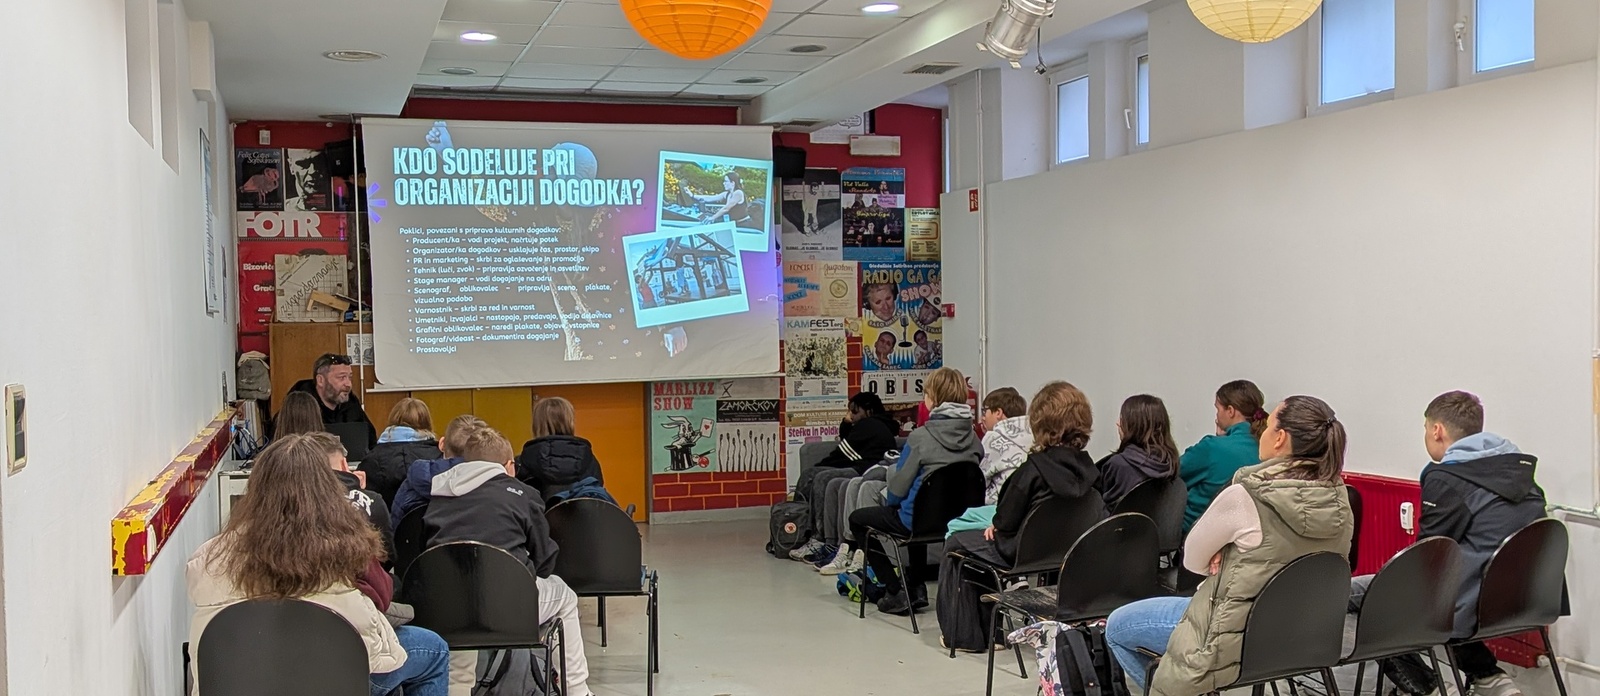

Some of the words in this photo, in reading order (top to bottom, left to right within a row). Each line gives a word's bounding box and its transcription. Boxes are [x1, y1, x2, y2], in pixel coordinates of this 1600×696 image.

[393, 147, 438, 174] KDO
[442, 148, 538, 176] SODELUJE
[542, 149, 576, 176] PRI
[394, 178, 534, 205] ORGANIZACIJI
[540, 178, 645, 206] DOGODKA?
[237, 211, 322, 237] FOTR
[526, 226, 561, 235] dogodkov:
[413, 246, 466, 255] Organizator/ka
[863, 269, 903, 284] RADIO
[907, 269, 923, 283] GA
[414, 286, 451, 294] Scenograf,
[450, 315, 478, 323] izvajalci
[416, 335, 474, 344] Fotograf/videast
[526, 333, 559, 341] dogajanje
[653, 382, 715, 396] MARLIZZ
[654, 397, 694, 411] SHOW
[820, 426, 839, 436] Poldk
